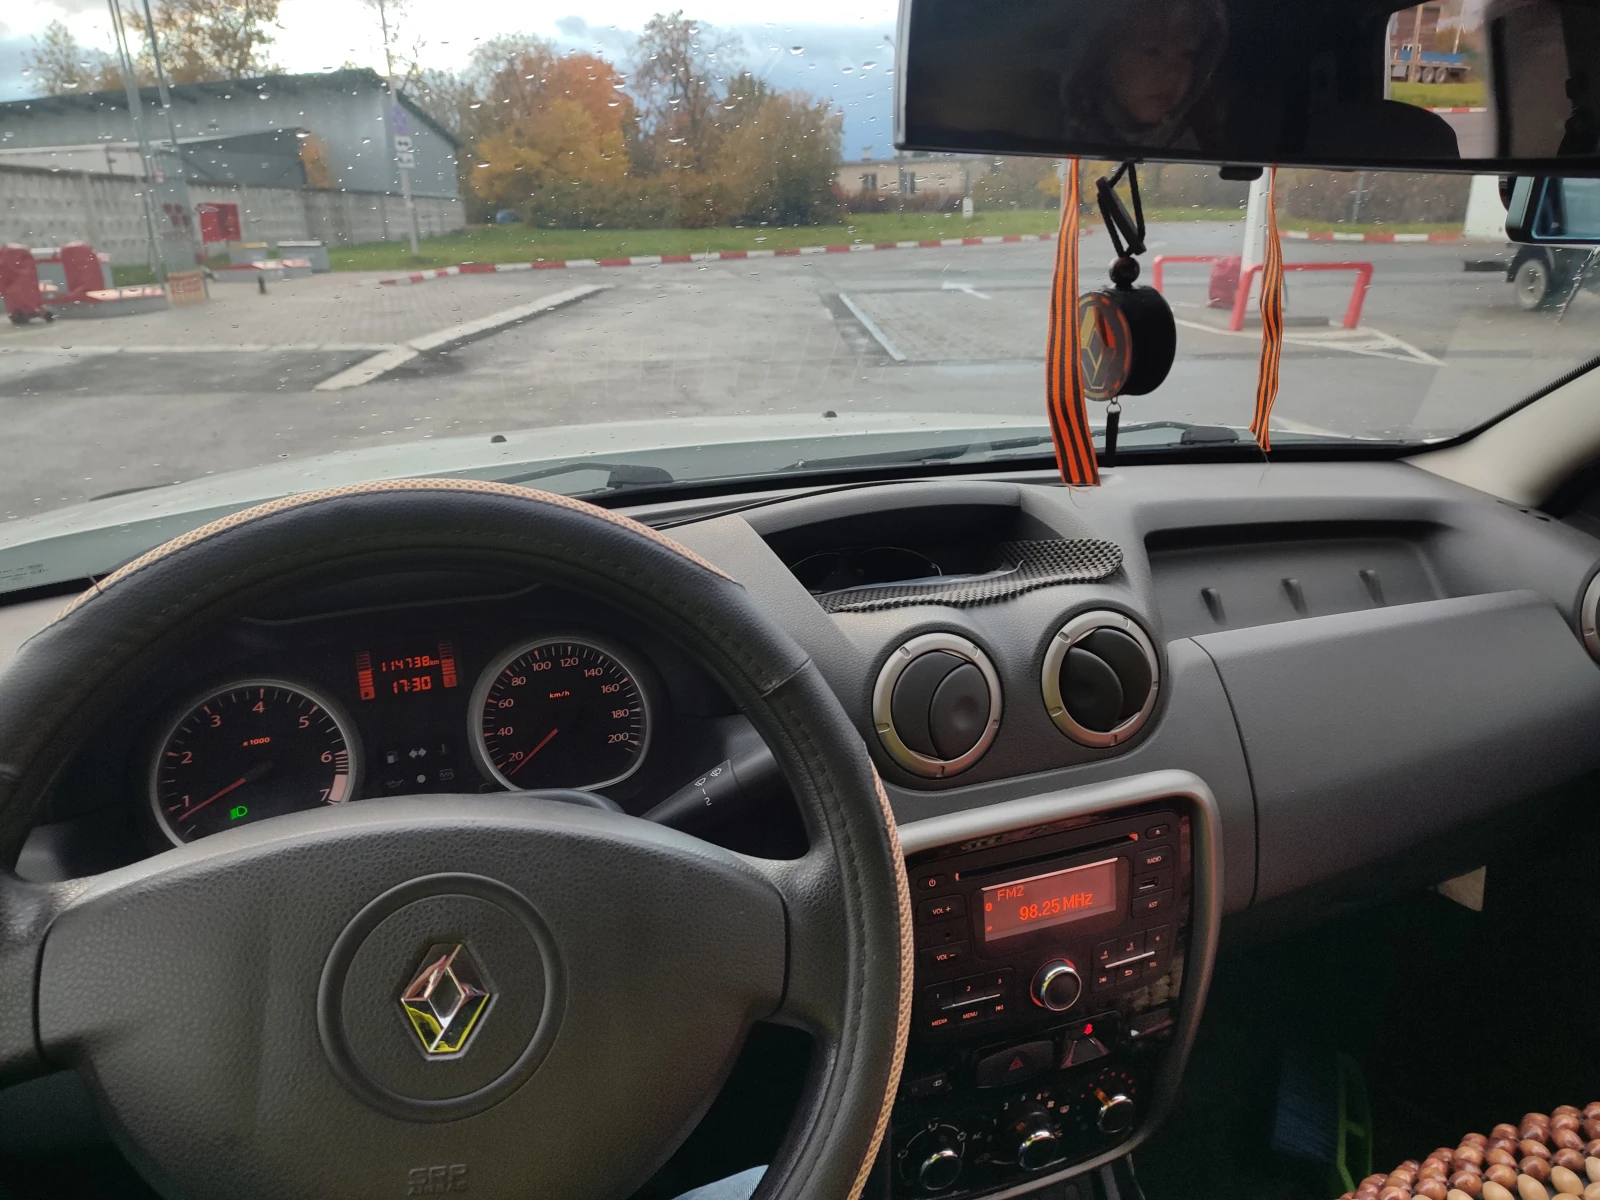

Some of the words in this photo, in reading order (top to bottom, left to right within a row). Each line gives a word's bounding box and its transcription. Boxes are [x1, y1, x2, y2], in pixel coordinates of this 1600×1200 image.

[531, 660, 552, 672] 100
[559, 656, 579, 668] 120
[583, 667, 603, 678] 140
[392, 675, 432, 694] 17:30
[511, 676, 527, 687] 80
[549, 690, 570, 699] km/h
[601, 683, 620, 694] 160
[252, 701, 265, 714] 4
[498, 698, 514, 709] 60
[611, 708, 630, 719] 180
[210, 715, 222, 728] 3
[298, 715, 310, 729] 5
[497, 726, 514, 737] 40
[607, 732, 629, 744] 200
[181, 750, 193, 765] 2
[320, 752, 332, 763] 6
[508, 751, 524, 763] 20
[182, 794, 190, 808] 1
[319, 788, 330, 802] 7
[997, 885, 1025, 902] FM2
[1019, 897, 1061, 921] 98.25
[1062, 892, 1093, 911] MHz
[962, 1011, 979, 1020] MENU
